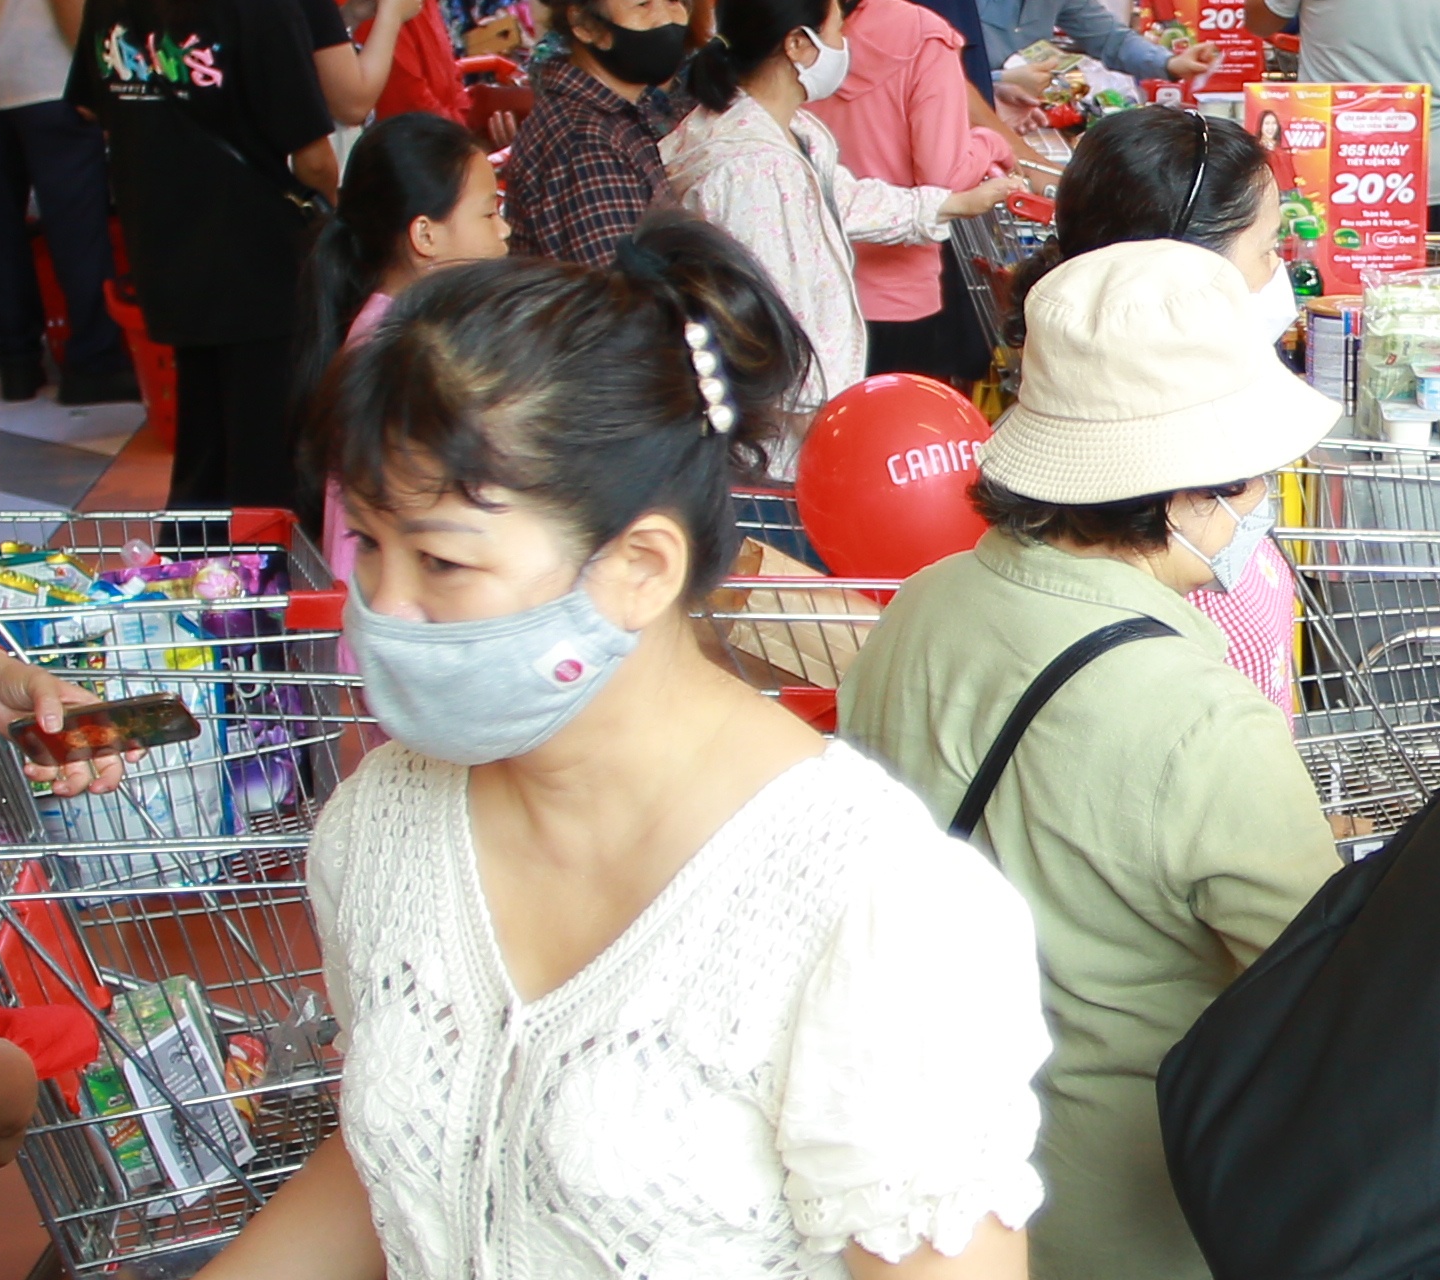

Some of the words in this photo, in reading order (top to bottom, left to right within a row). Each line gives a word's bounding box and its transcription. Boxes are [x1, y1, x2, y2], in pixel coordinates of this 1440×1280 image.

[1337, 143, 1367, 157] 365
[1367, 141, 1410, 157] NGÀY
[1330, 172, 1416, 205] 20%
